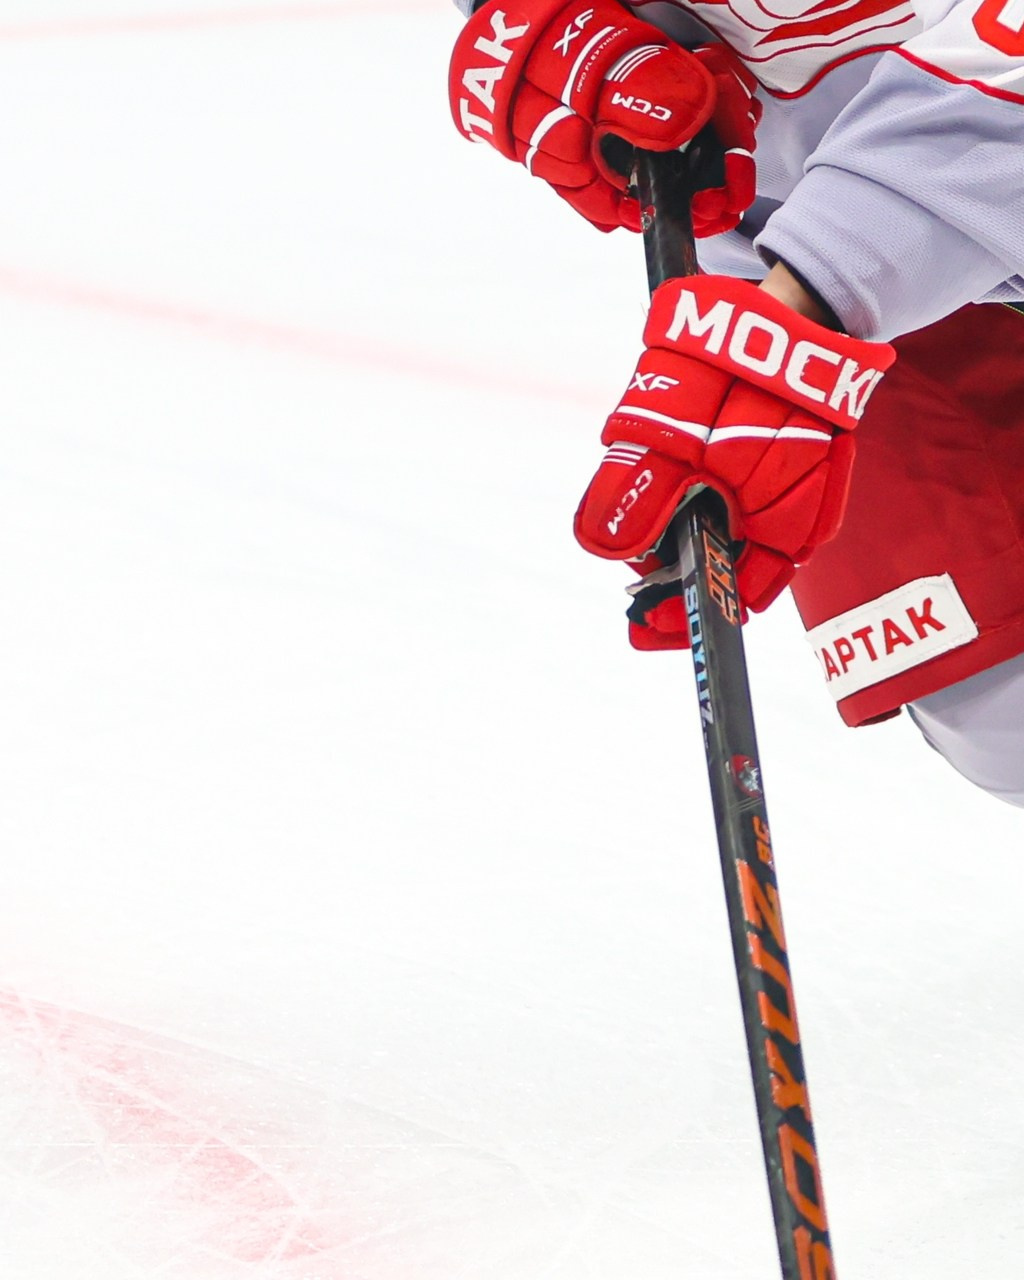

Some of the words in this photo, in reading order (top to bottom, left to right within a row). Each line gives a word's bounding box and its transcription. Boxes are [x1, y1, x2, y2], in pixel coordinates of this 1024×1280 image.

[553, 8, 594, 56] XF
[459, 9, 530, 142] ТАК
[611, 91, 673, 122] CCM
[629, 372, 679, 393] XF
[665, 289, 885, 420] МОСК
[607, 469, 654, 536] CCM
[820, 597, 946, 682] АРТАК
